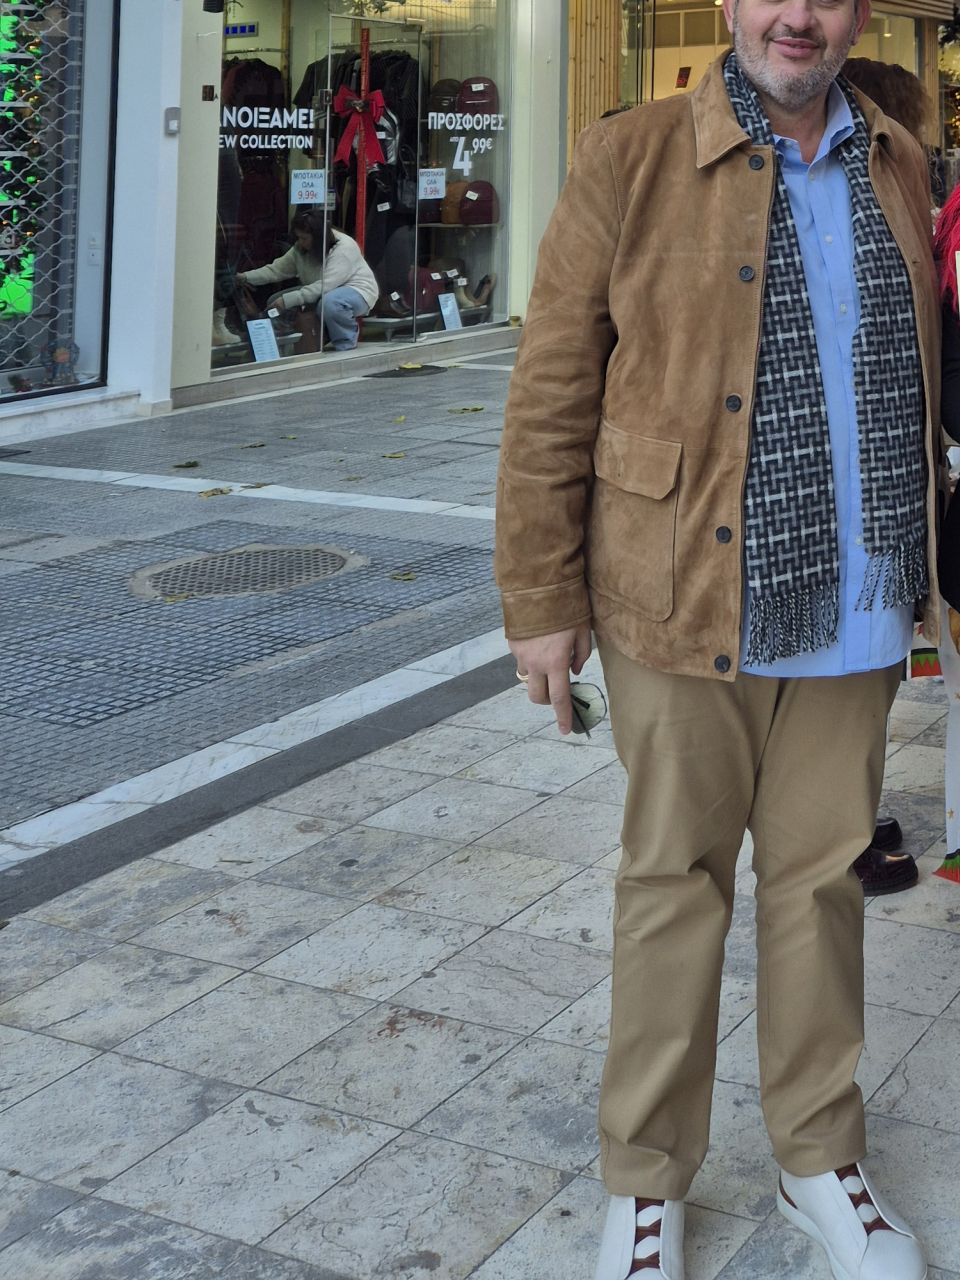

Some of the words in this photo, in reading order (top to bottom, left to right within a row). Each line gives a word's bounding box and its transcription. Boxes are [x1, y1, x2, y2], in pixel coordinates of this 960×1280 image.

[219, 106, 315, 129] ΝΟΙΞΑΜΕ!
[428, 112, 505, 131] ΠΡΟΣΦΟΡΕΣ
[219, 134, 237, 149] EW
[240, 134, 313, 149] COLLECTION
